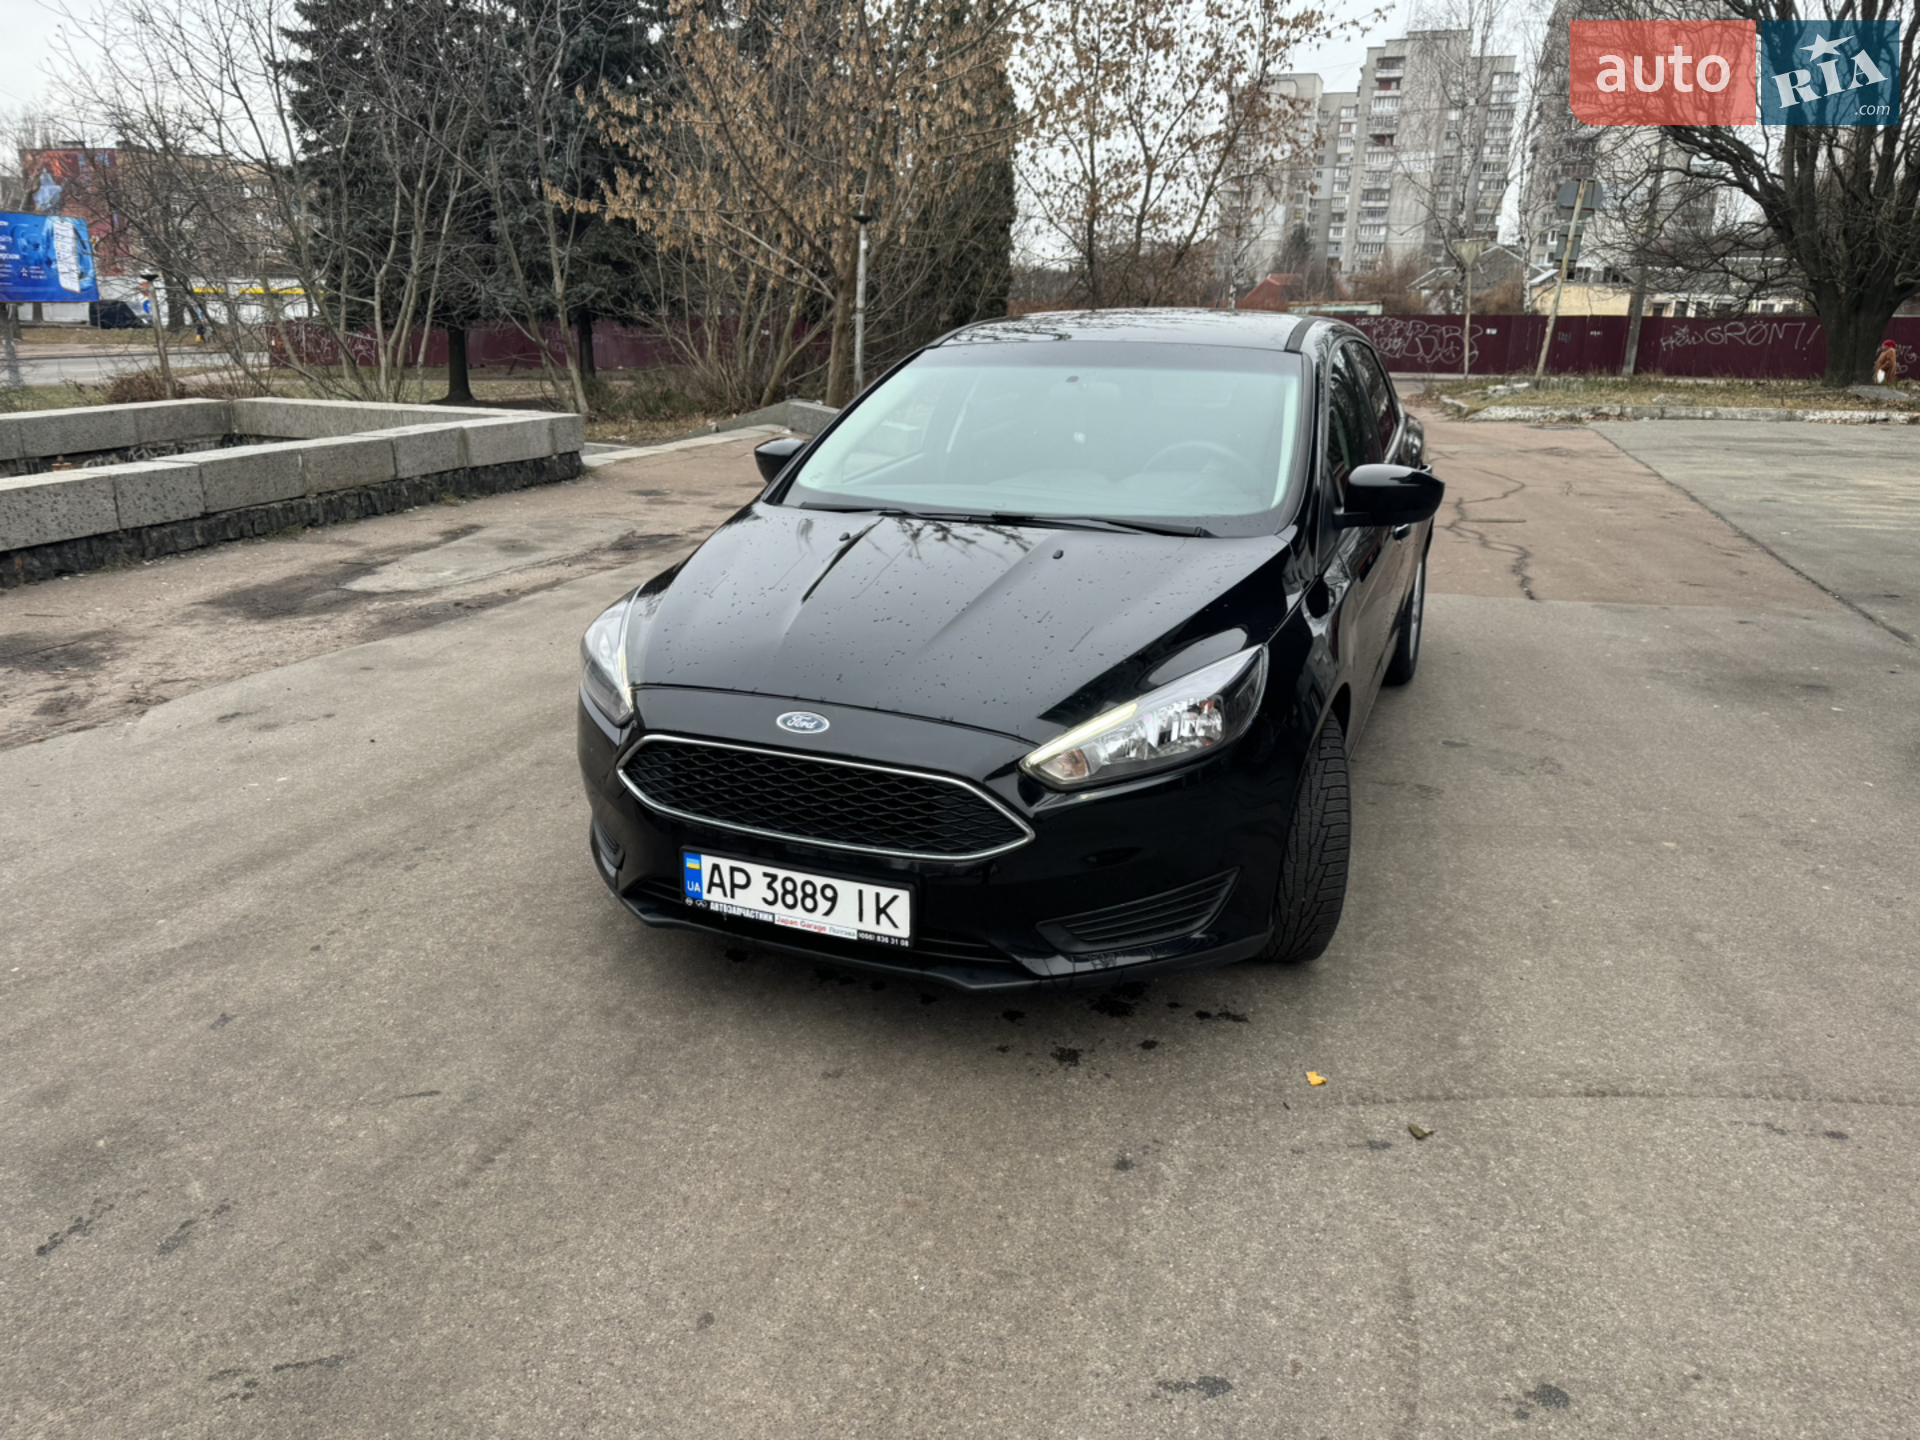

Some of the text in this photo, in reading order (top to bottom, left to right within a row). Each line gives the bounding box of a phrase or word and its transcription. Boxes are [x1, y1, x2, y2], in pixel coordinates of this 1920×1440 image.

[786, 714, 818, 729] Ford
[687, 881, 702, 893] UA
[706, 863, 900, 929] AP 3889 IK
[799, 919, 828, 933] Garage
